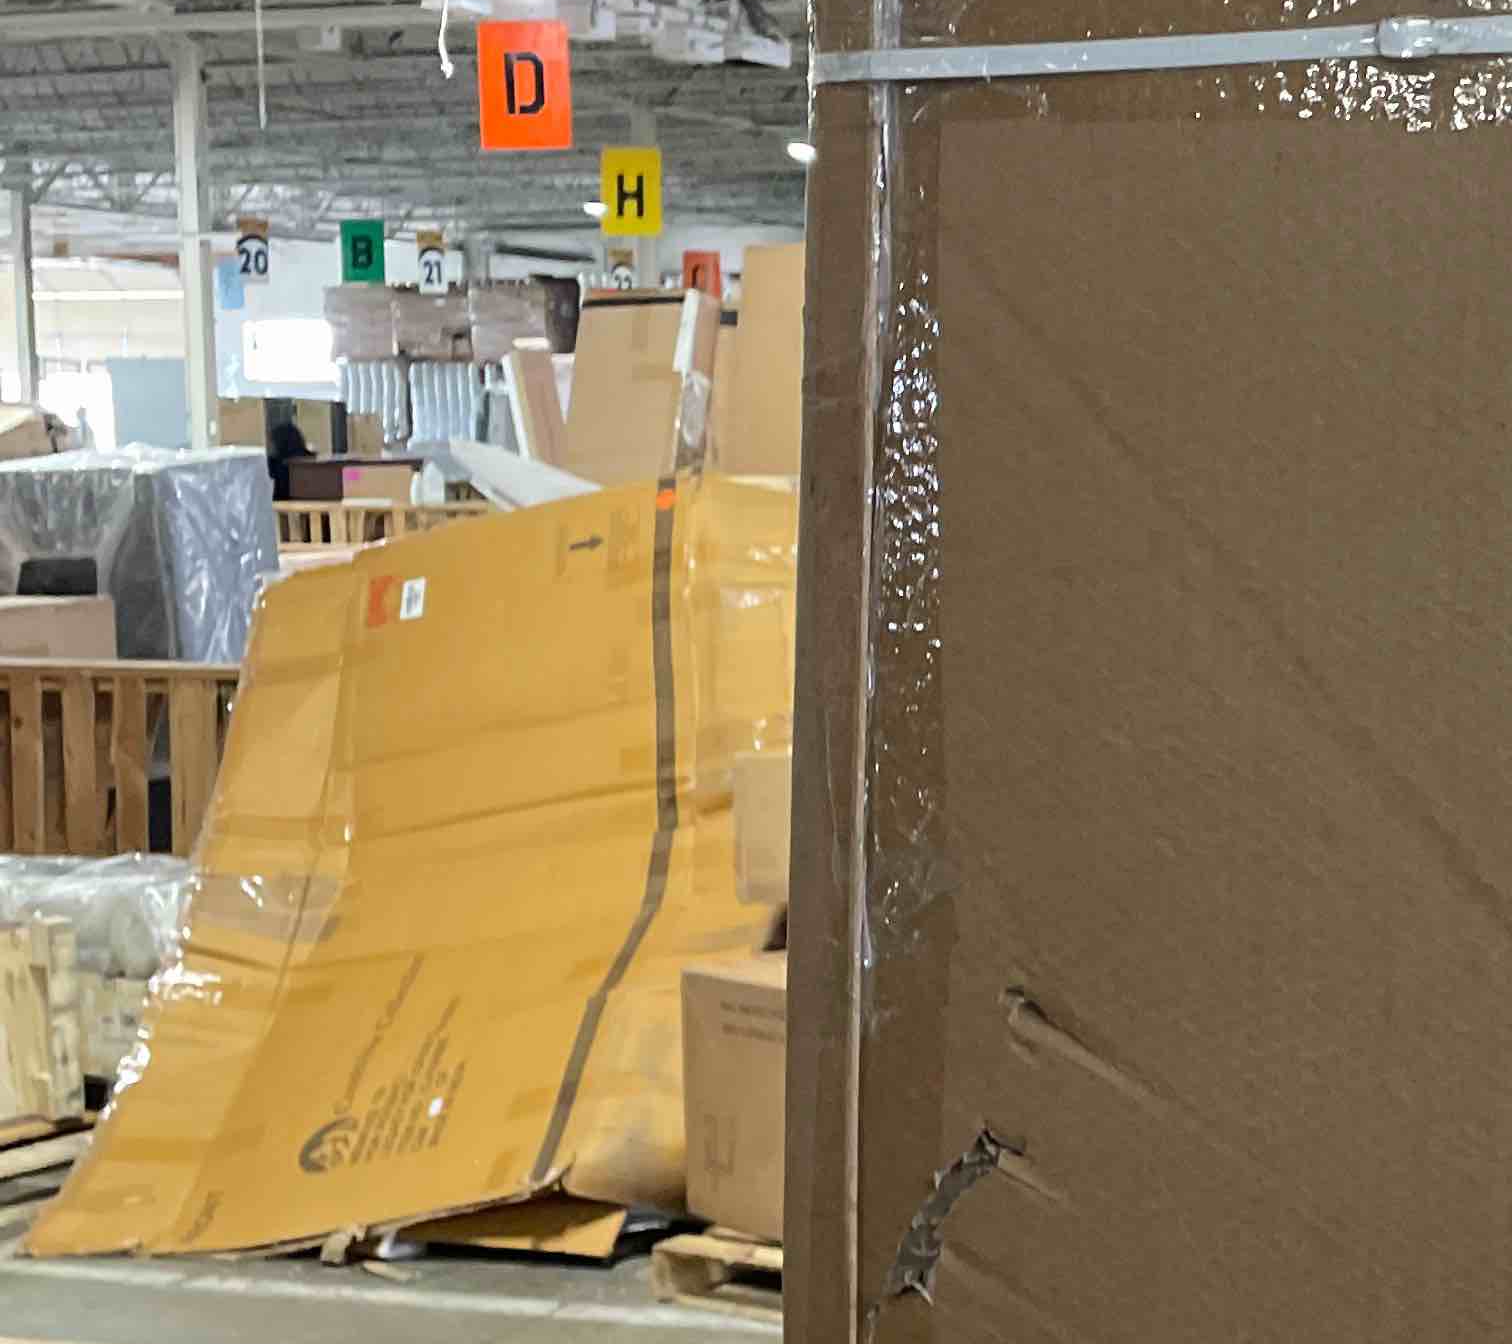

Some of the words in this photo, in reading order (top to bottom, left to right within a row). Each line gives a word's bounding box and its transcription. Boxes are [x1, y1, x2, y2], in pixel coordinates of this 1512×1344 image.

[504, 51, 545, 114] D
[616, 173, 644, 218] H
[239, 248, 269, 275] 20
[352, 235, 373, 269] B
[424, 260, 442, 284] 21
